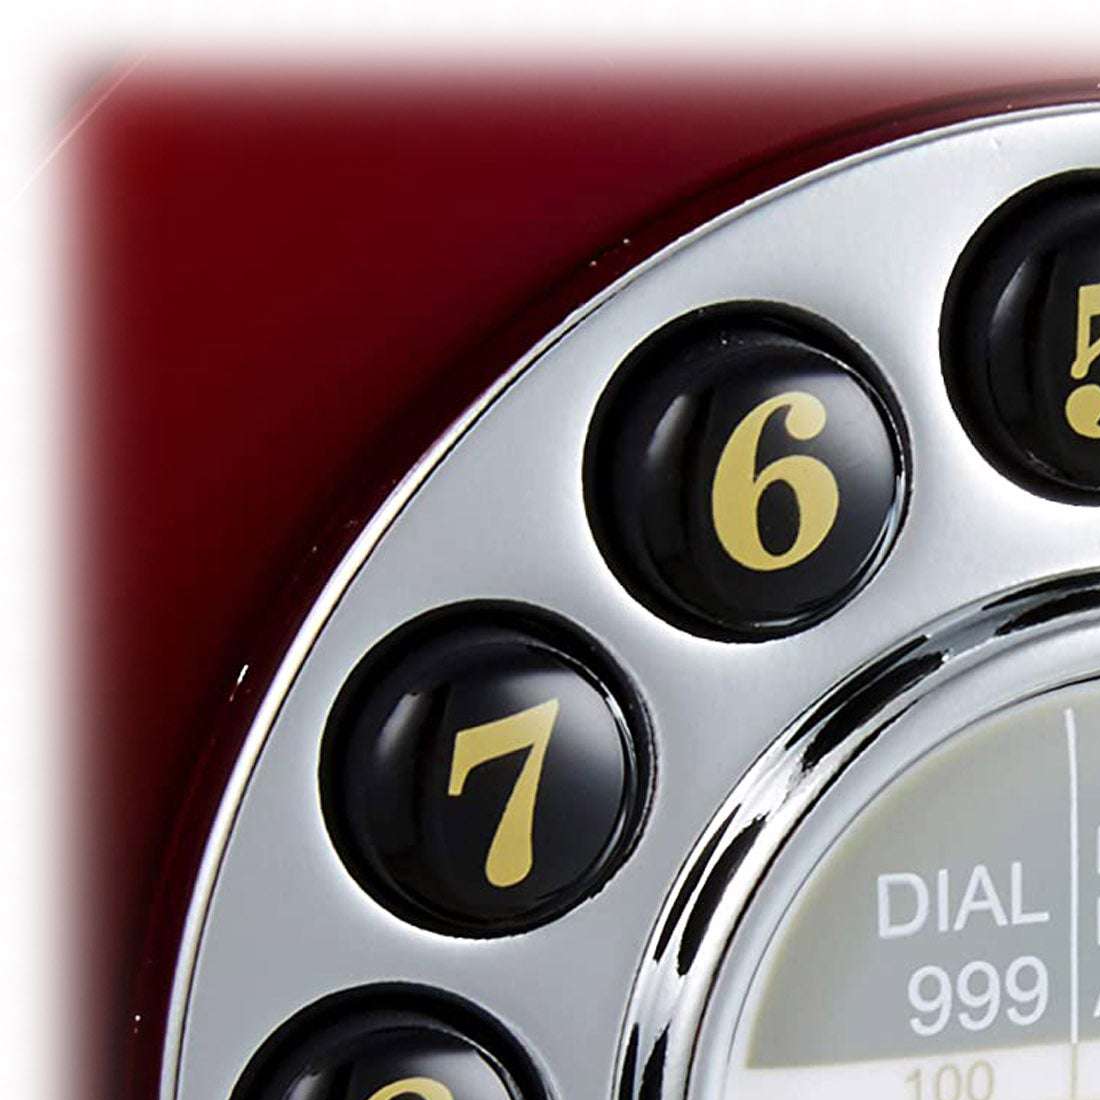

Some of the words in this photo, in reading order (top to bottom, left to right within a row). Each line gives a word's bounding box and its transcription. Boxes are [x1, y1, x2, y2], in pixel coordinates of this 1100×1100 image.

[711, 392, 841, 571] 6
[447, 702, 561, 888] 7
[876, 861, 1050, 940] DIAL
[906, 956, 1050, 1037] 999
